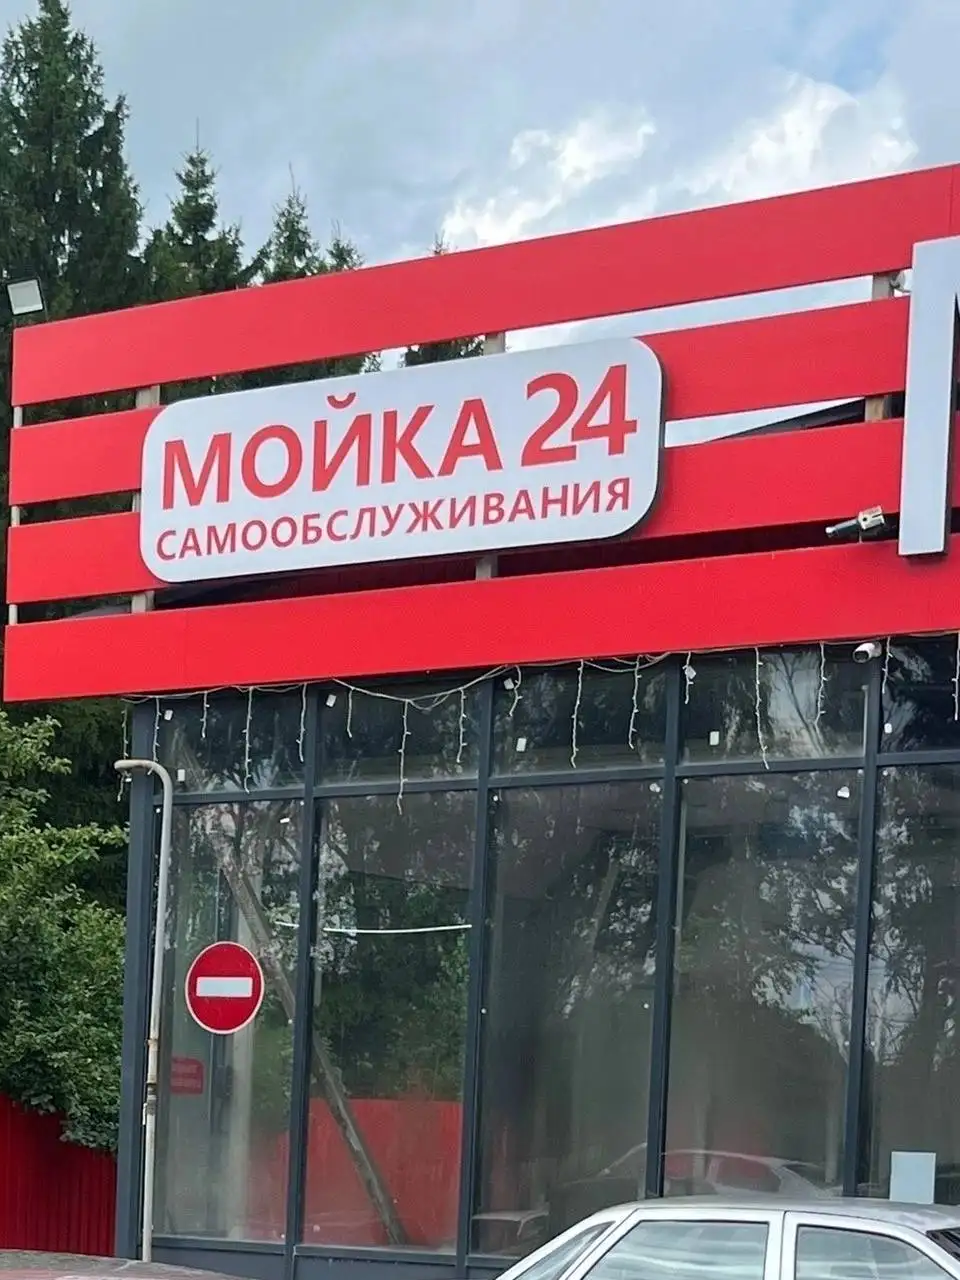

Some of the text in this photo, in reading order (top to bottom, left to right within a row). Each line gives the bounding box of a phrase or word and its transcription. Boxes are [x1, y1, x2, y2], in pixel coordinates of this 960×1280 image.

[162, 364, 637, 509] МОЙКА 24
[156, 477, 630, 560] САМООБСЛУЖИВАНИЯ
